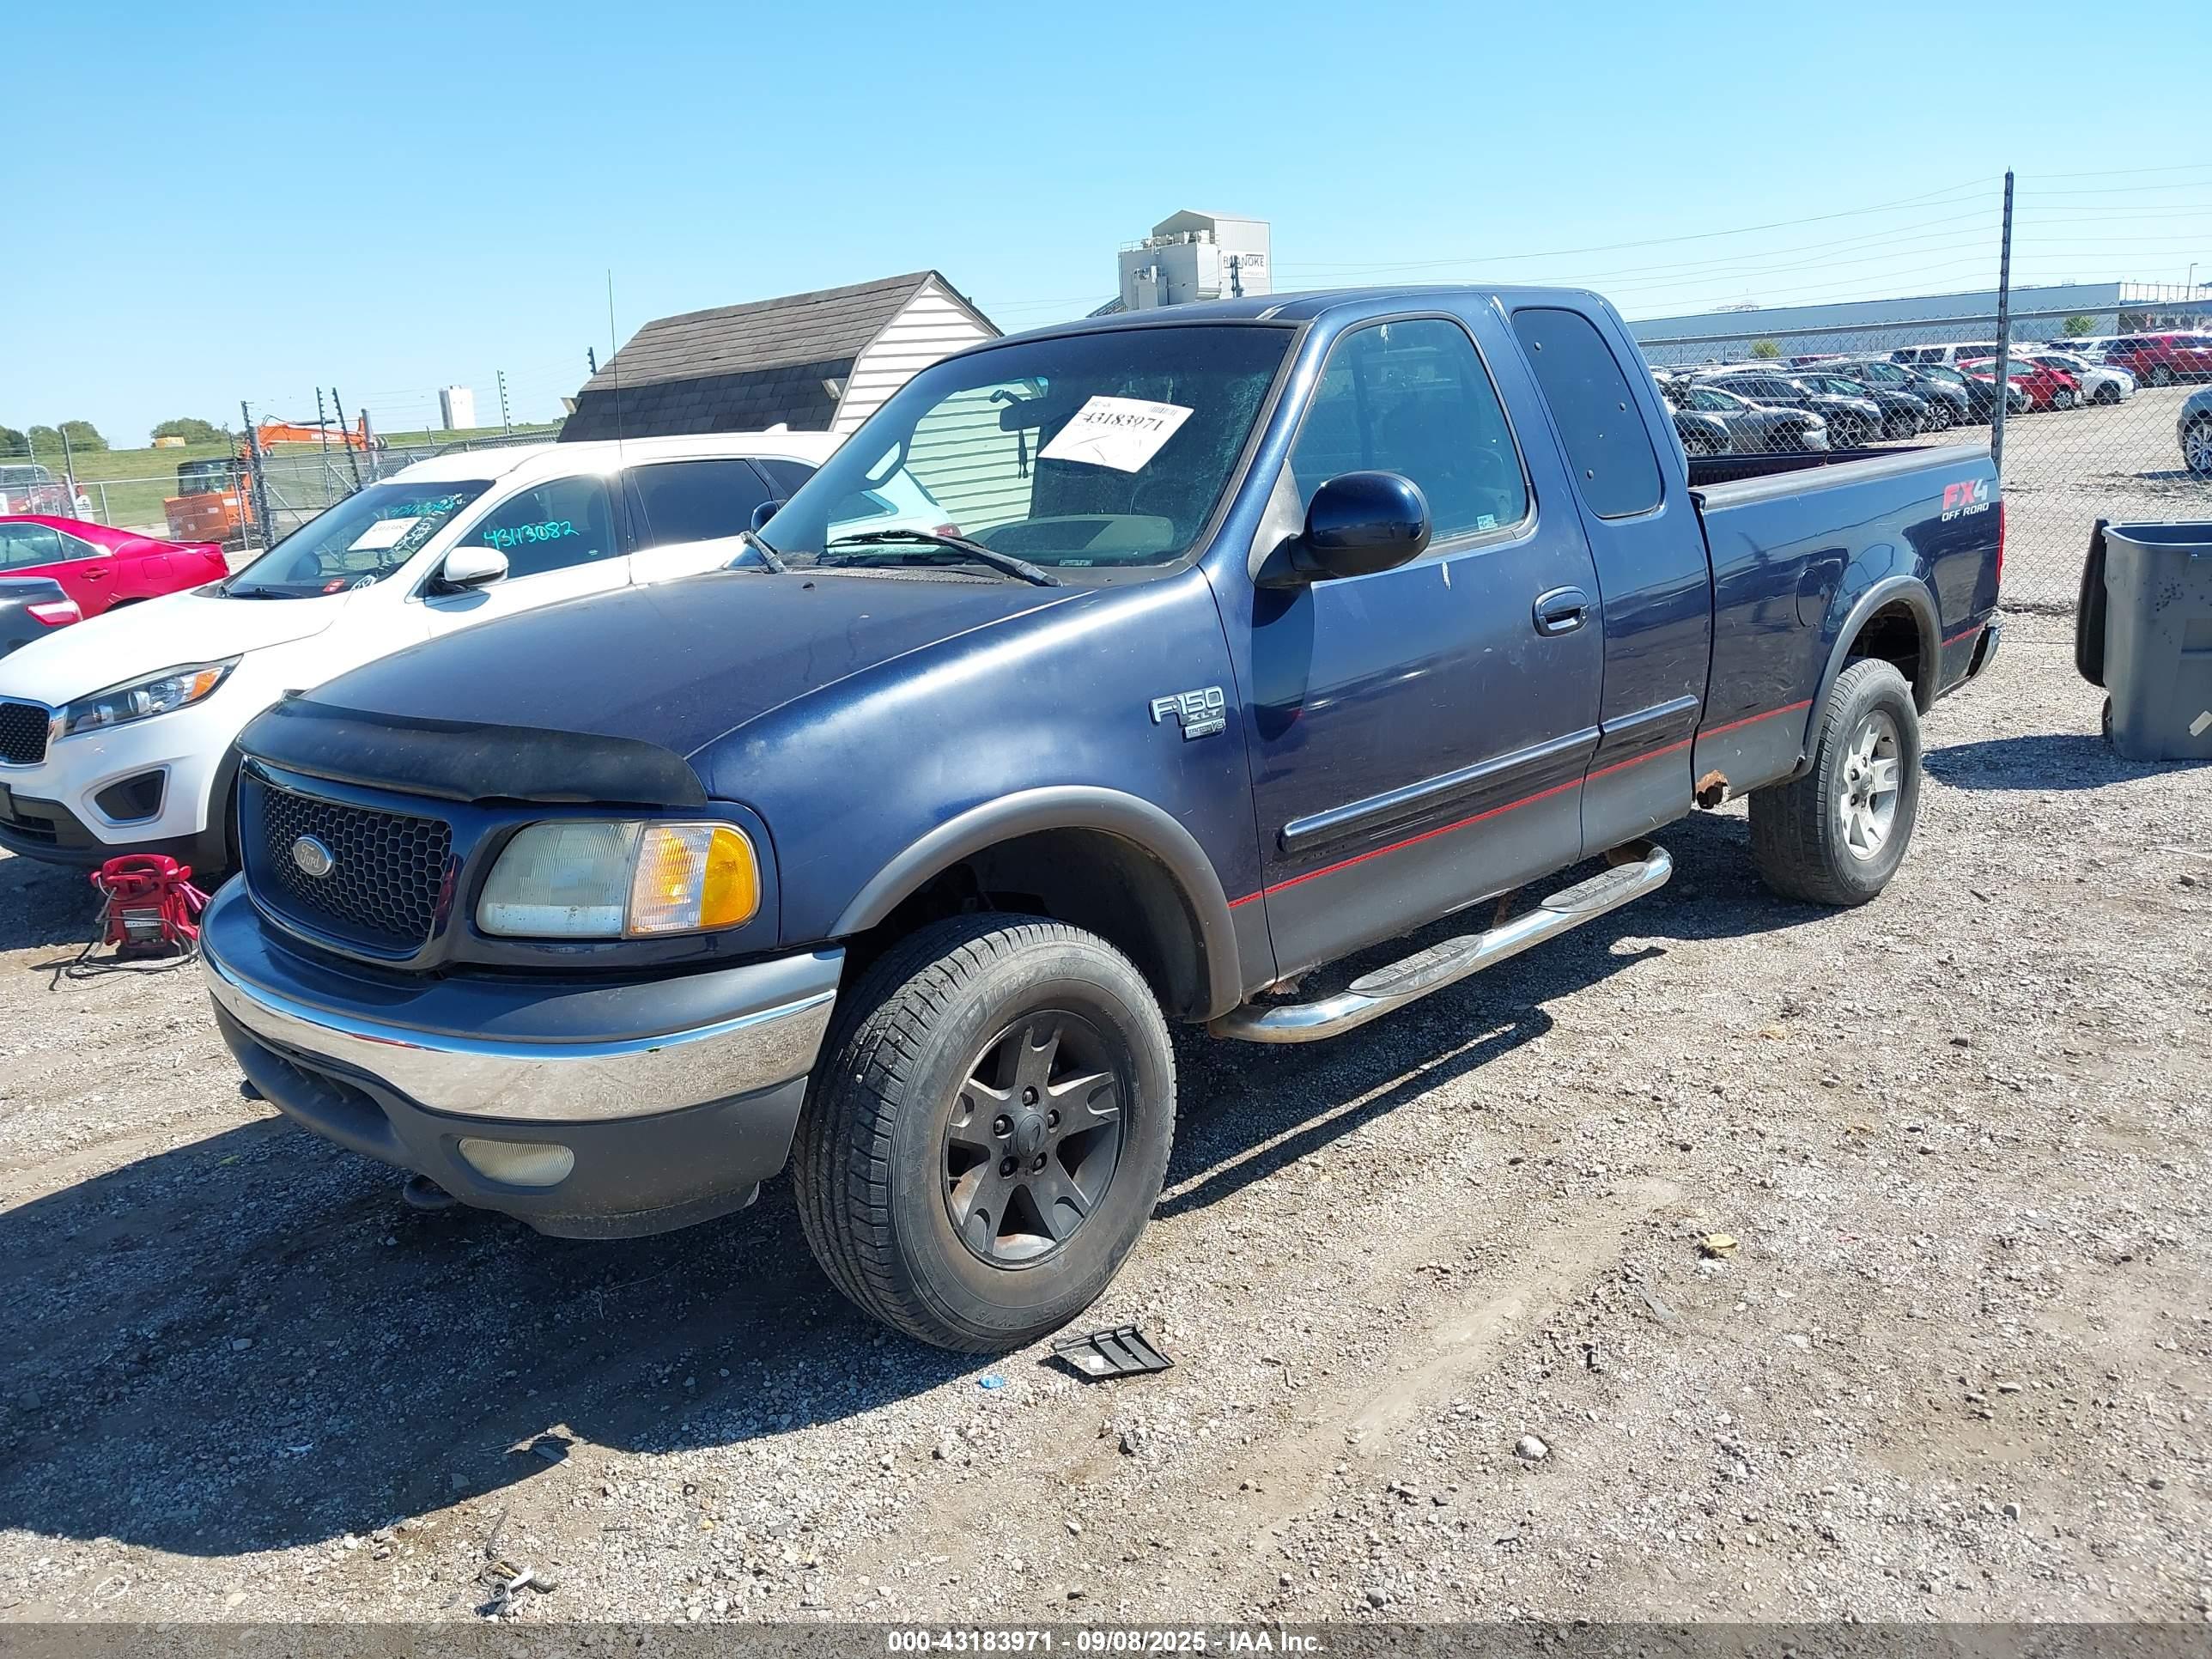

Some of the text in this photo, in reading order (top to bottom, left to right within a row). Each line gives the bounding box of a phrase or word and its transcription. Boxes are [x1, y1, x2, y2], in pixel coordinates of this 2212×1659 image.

[1084, 412, 1164, 431] 43183971
[1942, 478, 1989, 511] FX4
[1942, 502, 1990, 522] OFF ROAD
[483, 520, 580, 550] 43113082
[1187, 709, 1219, 721] XLT
[300, 843, 320, 869] Ford
